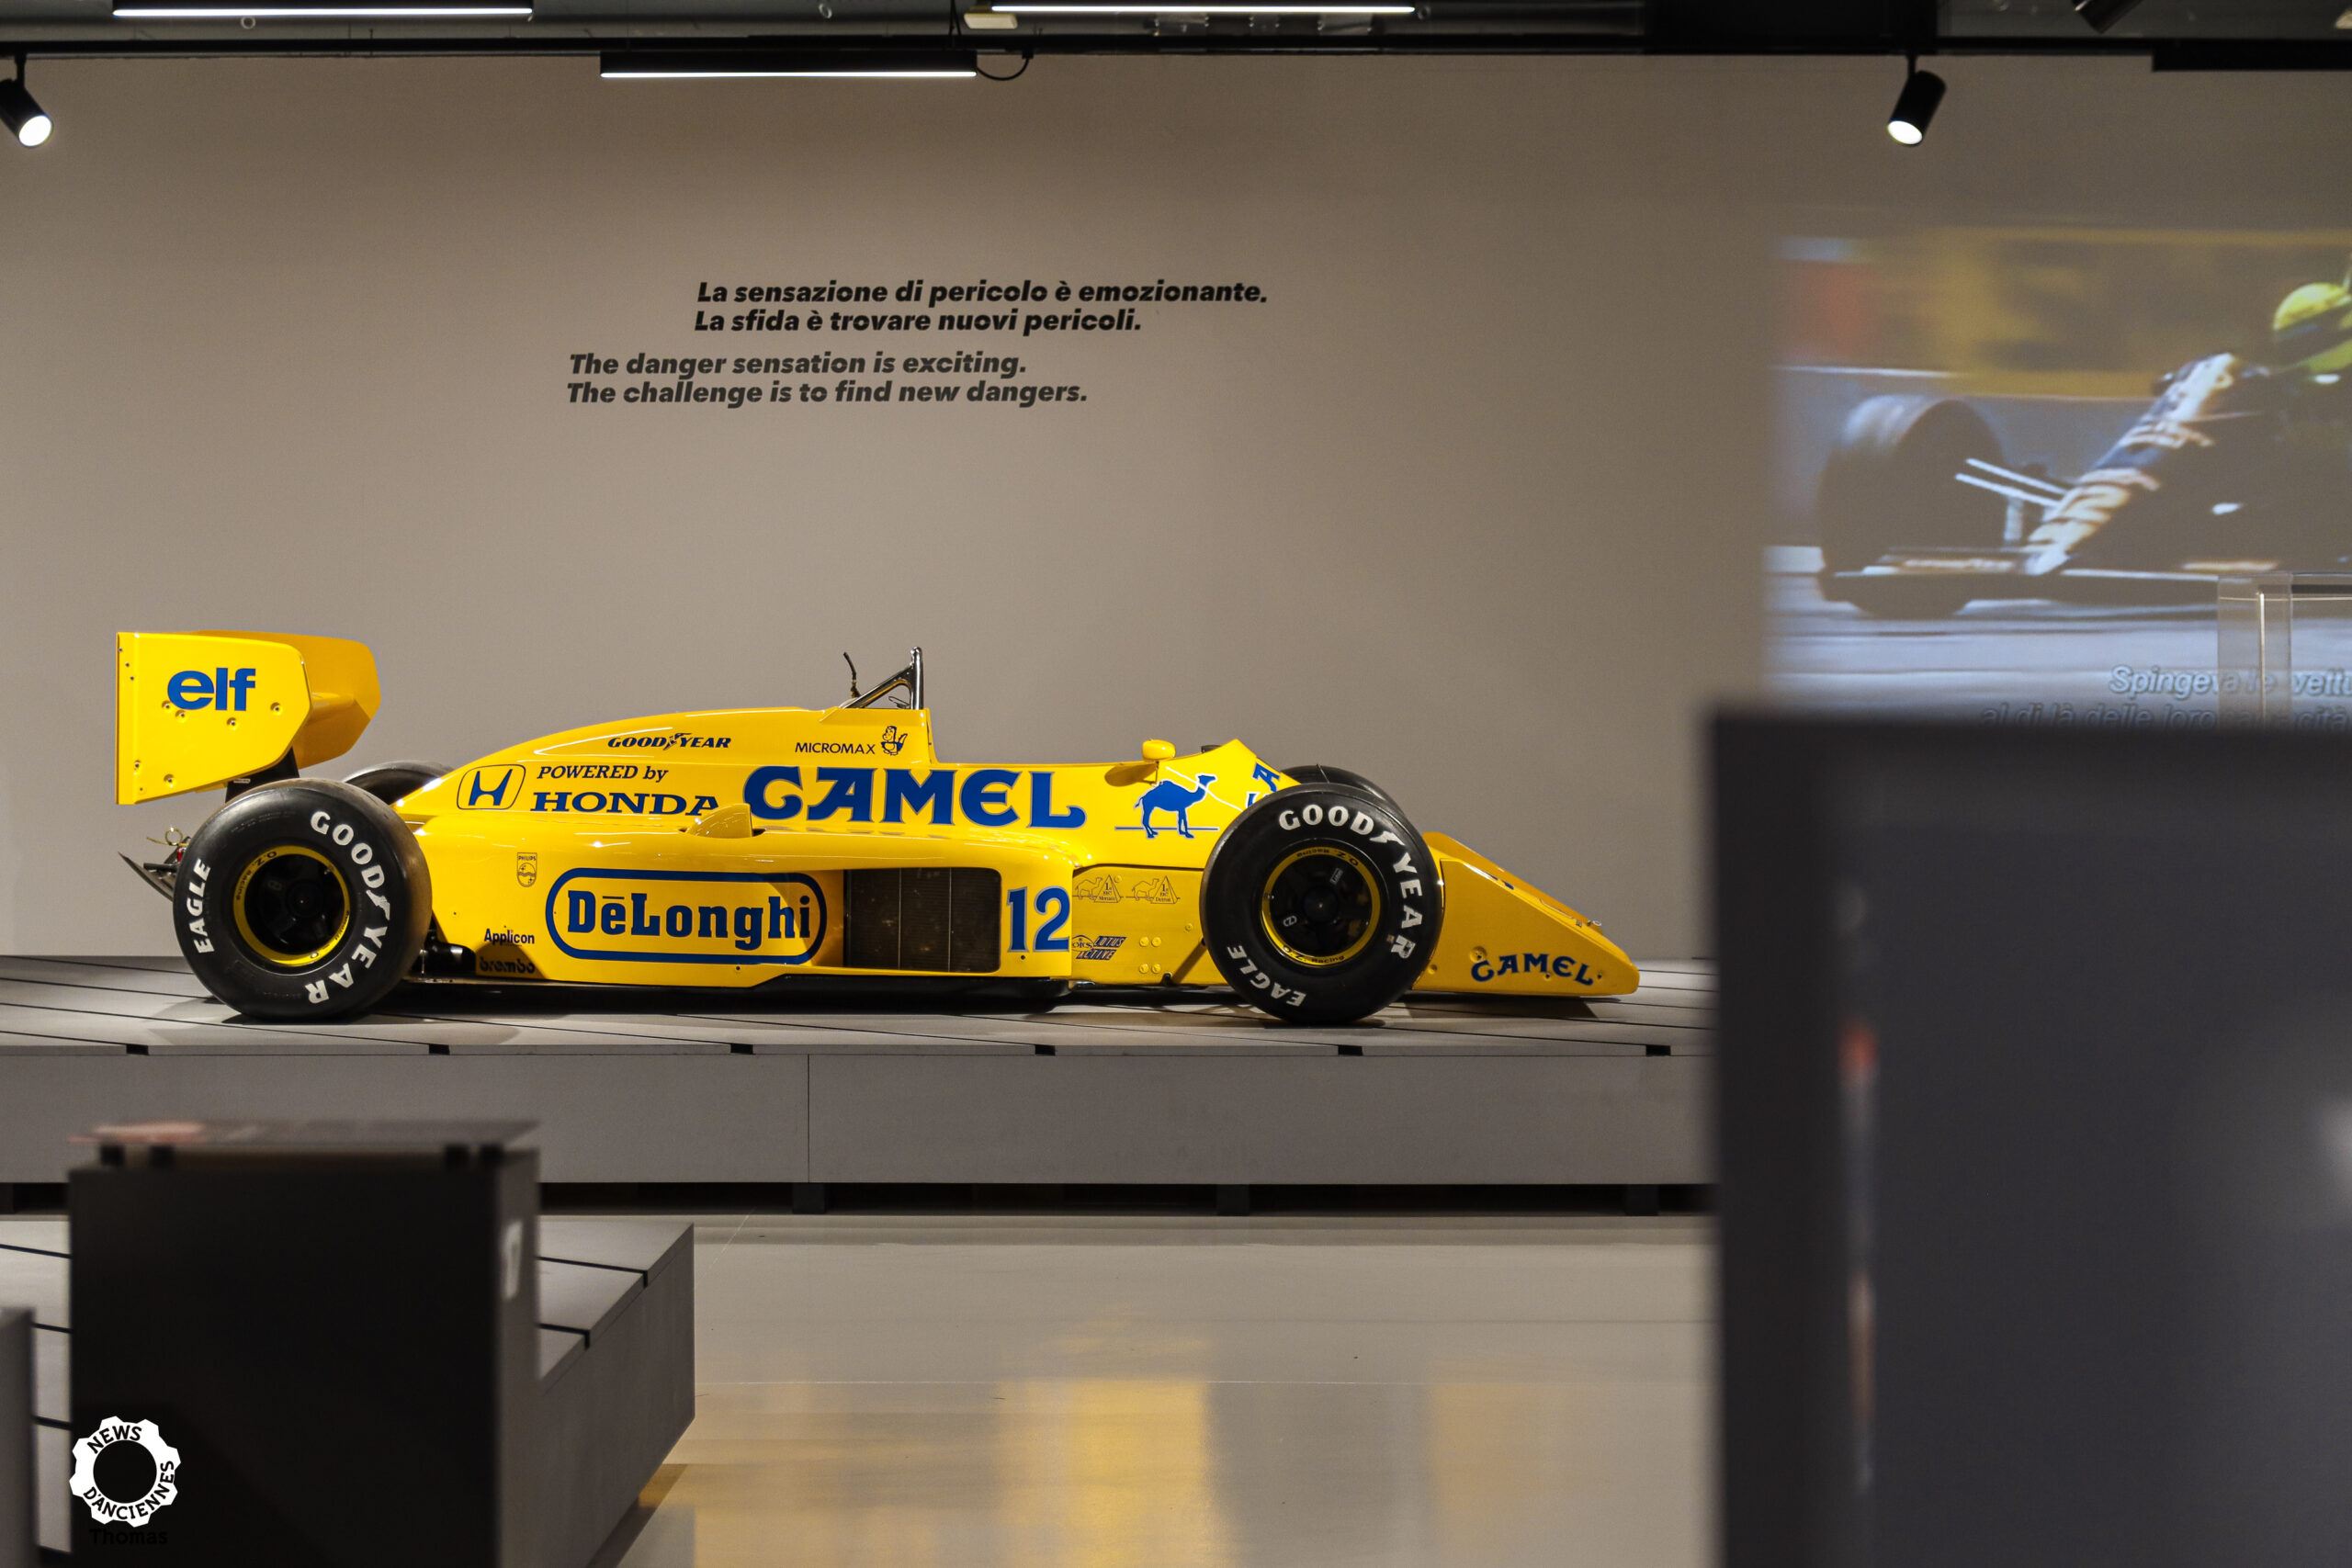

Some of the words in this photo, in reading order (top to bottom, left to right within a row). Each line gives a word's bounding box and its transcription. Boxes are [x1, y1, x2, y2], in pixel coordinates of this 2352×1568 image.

[697, 281, 728, 303] La
[734, 279, 888, 303] sensazione
[895, 279, 923, 303] di
[928, 279, 1047, 308] pericolo
[1055, 281, 1071, 303] è
[1079, 278, 1268, 303] emozionante.
[695, 310, 725, 332] La
[731, 309, 799, 332] sfida
[807, 310, 823, 332] è
[831, 310, 931, 332] trovare
[938, 308, 1019, 331] nuovi
[1023, 308, 1141, 337] pericoli.
[570, 353, 619, 375] The
[626, 353, 727, 380] danger
[732, 351, 866, 375] sensation
[874, 351, 896, 374] is
[902, 351, 1027, 379] exciting.
[567, 381, 616, 403] The
[623, 380, 763, 409] challenge
[770, 379, 792, 402] is
[799, 383, 828, 402] to
[835, 379, 893, 402] find
[899, 384, 959, 402] new
[967, 380, 1088, 408] dangers.
[167, 667, 257, 712] elf
[795, 742, 876, 754] MICROMAX
[537, 765, 639, 779] POWERED
[644, 765, 669, 783] by
[530, 792, 719, 816] HONDA
[742, 765, 1087, 829] CAMEL
[186, 858, 215, 953] EAGLE
[1007, 886, 1070, 953] 12
[484, 928, 535, 945] Applicon
[1093, 936, 1125, 947] LOTUS
[480, 956, 536, 974] brembo
[1227, 944, 1307, 1007] EAGLE
[1471, 953, 1594, 986] CAMEL
